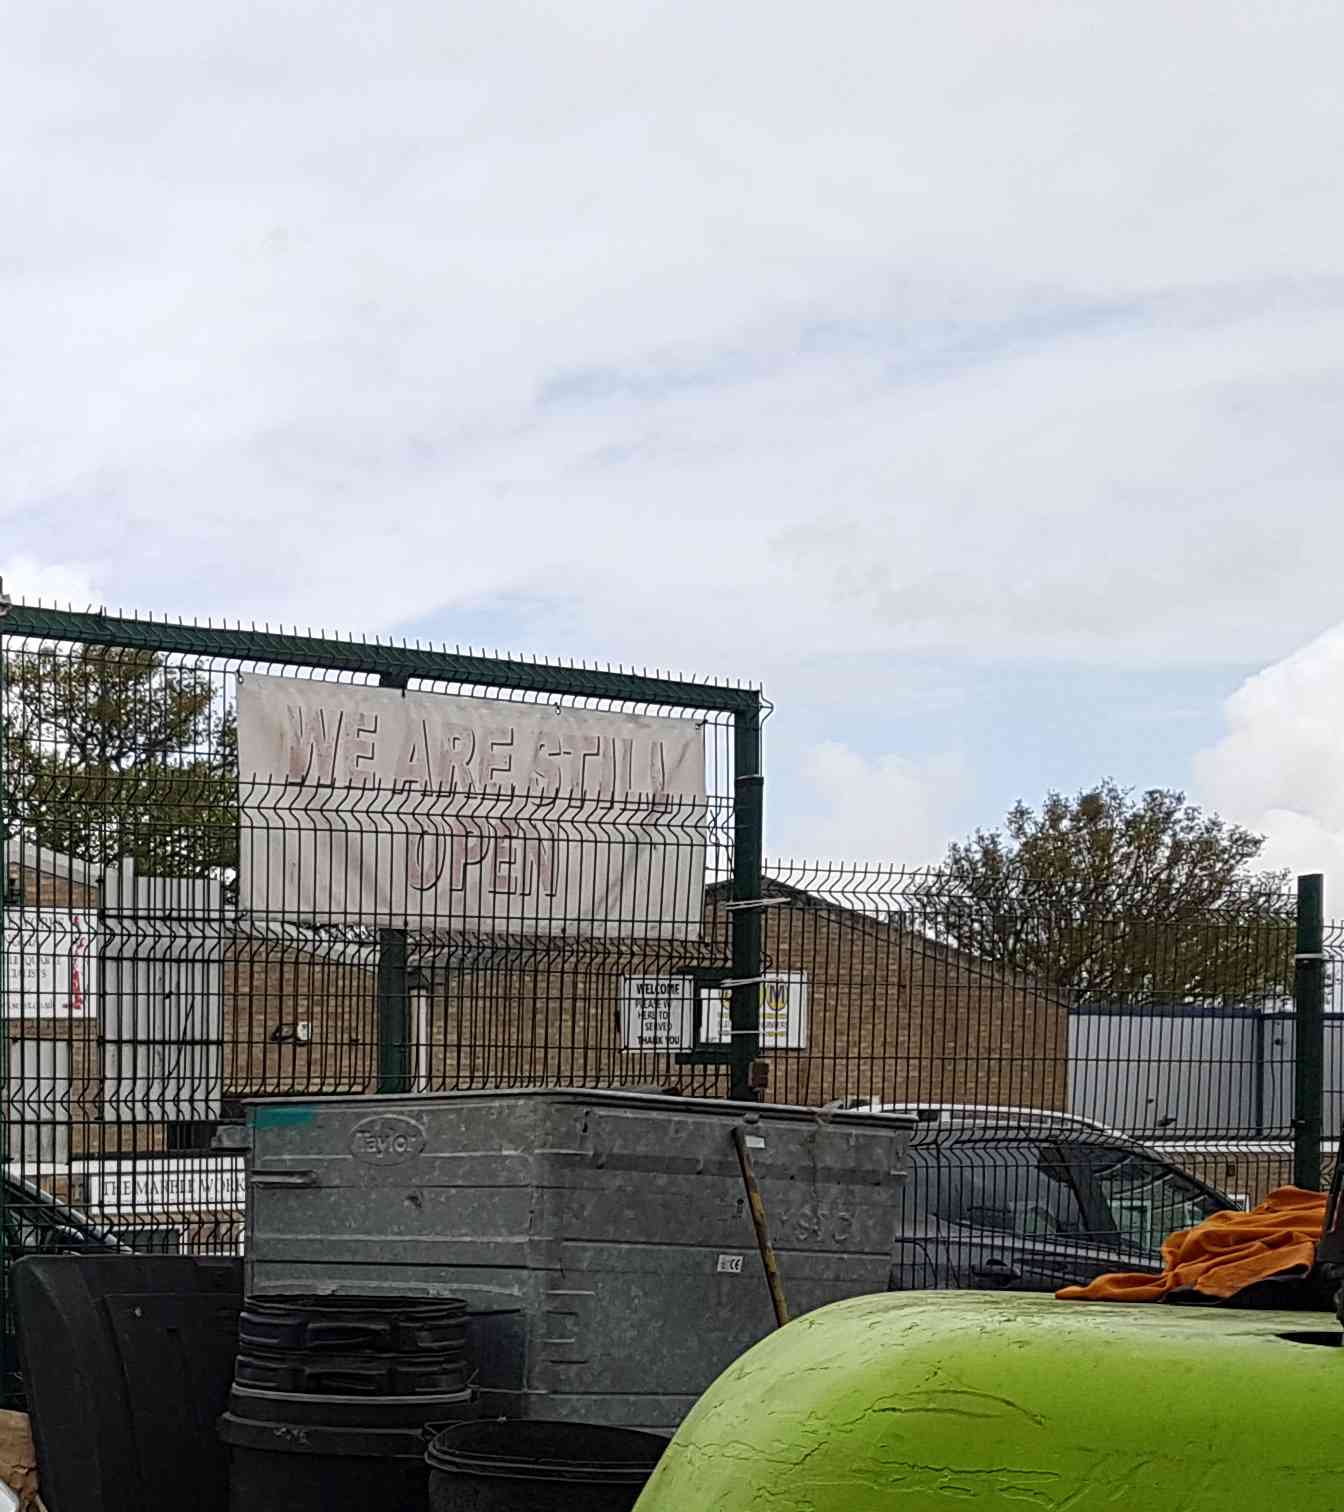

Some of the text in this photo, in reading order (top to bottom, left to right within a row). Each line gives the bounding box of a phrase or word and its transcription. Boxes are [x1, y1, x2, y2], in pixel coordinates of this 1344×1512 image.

[287, 704, 674, 813] WE ARE STILL
[408, 818, 558, 897] OPEN
